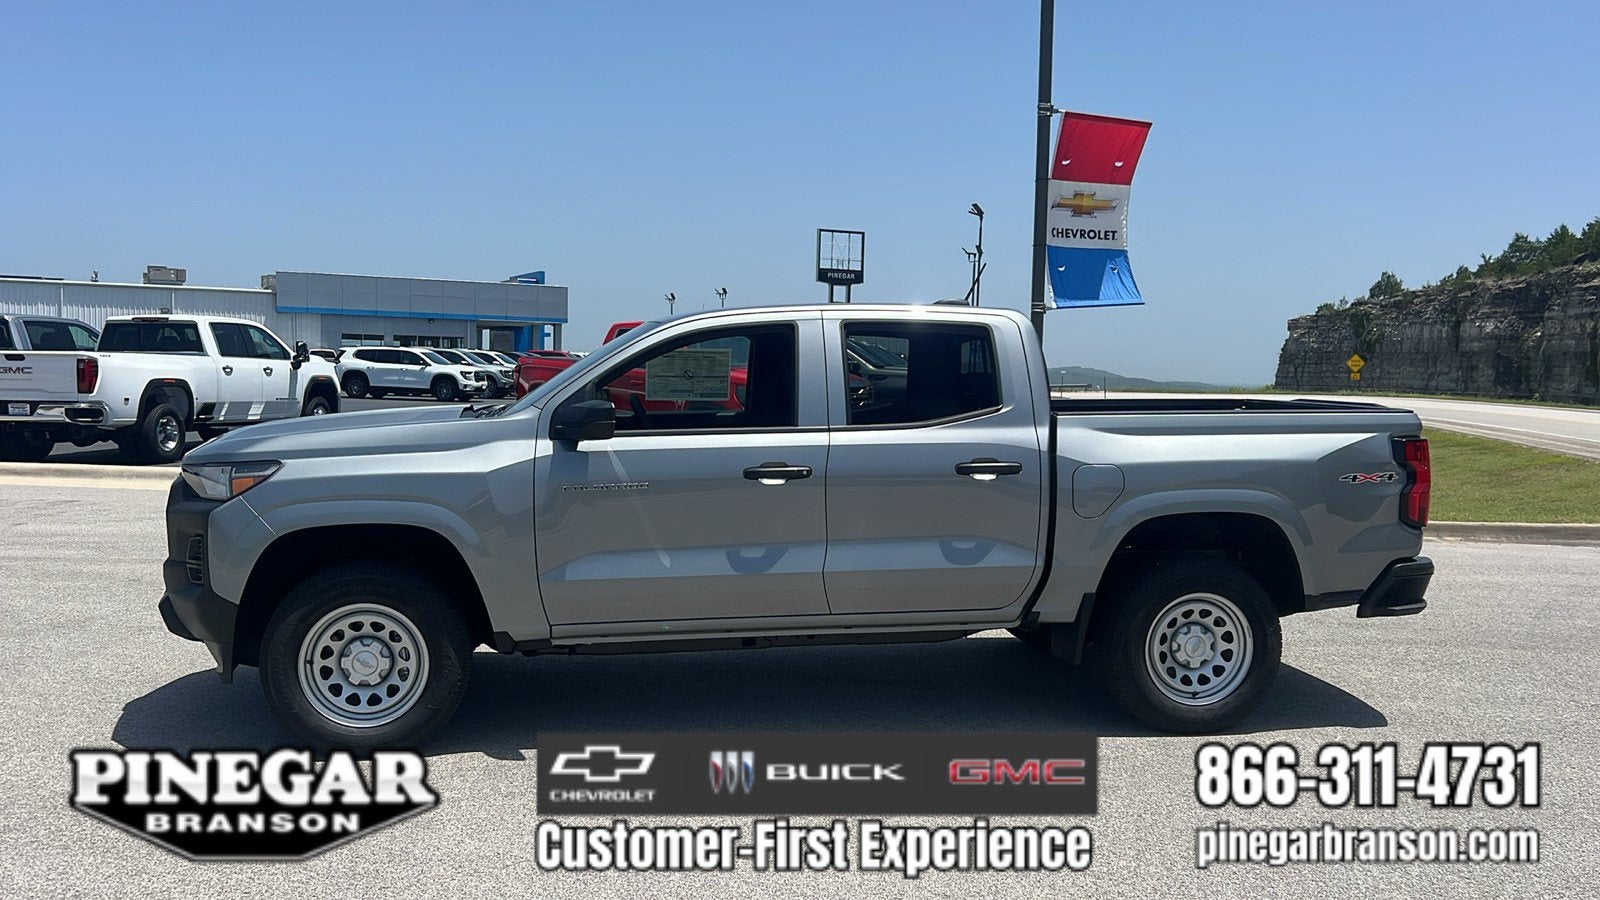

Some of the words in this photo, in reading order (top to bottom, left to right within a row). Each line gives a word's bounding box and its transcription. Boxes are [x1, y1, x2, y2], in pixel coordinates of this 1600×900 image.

[1051, 227, 1118, 241] CHEVROLET
[827, 272, 855, 280] PINEGAR
[0, 366, 33, 374] GMC
